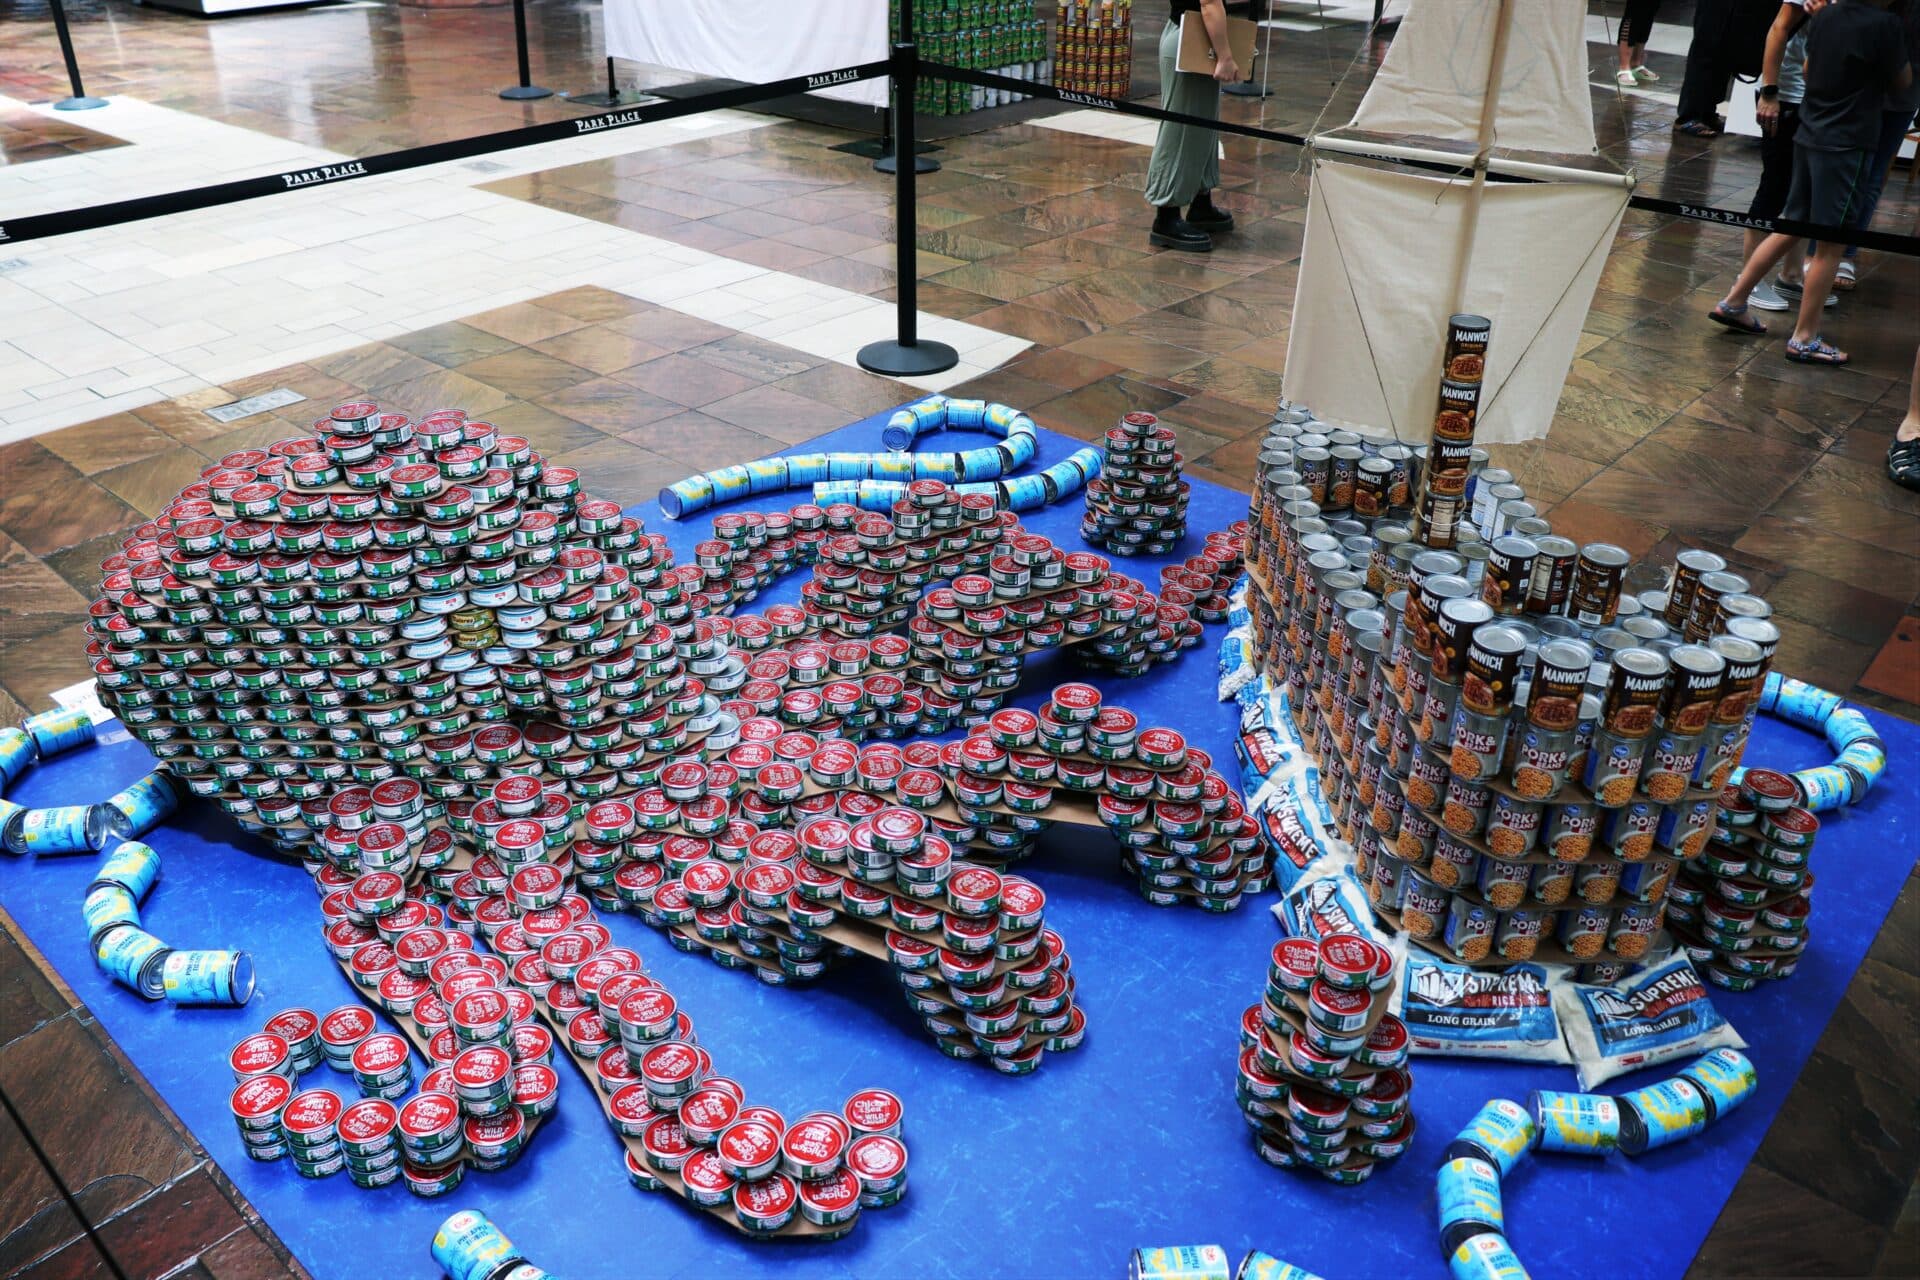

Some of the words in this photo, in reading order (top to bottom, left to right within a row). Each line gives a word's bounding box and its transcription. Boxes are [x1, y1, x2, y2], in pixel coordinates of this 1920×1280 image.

[807, 76, 831, 88] PARK
[832, 69, 859, 83] PLACE
[576, 119, 604, 132] PARK
[607, 111, 641, 126] PLACE
[282, 170, 321, 187] PARK
[322, 162, 367, 179] PLACE
[1680, 205, 1721, 221] PARK
[1723, 212, 1775, 230] PLACE
[1542, 666, 1587, 684] MANWICH
[1522, 744, 1568, 762] PORK&
[1536, 758, 1562, 769] BEANS
[1496, 804, 1538, 823] PORK&
[1630, 969, 1700, 1011] SUPREME
[627, 994, 663, 1009] Chicken
[1492, 995, 1515, 1006] RICE
[1666, 992, 1686, 1006] RICE
[1428, 1014, 1459, 1026] LONG
[1462, 1016, 1496, 1026] GRAIN
[1623, 1023, 1653, 1038] LONG
[241, 1055, 277, 1066] Chicken
[460, 1068, 495, 1080] Chicken
[417, 1101, 450, 1114] Chicken
[855, 1100, 891, 1109] Chicken
[291, 1113, 326, 1125] Chicken
[484, 1127, 503, 1135] WILD
[791, 1144, 828, 1157] Chicken
[812, 1190, 851, 1201] Chicken
